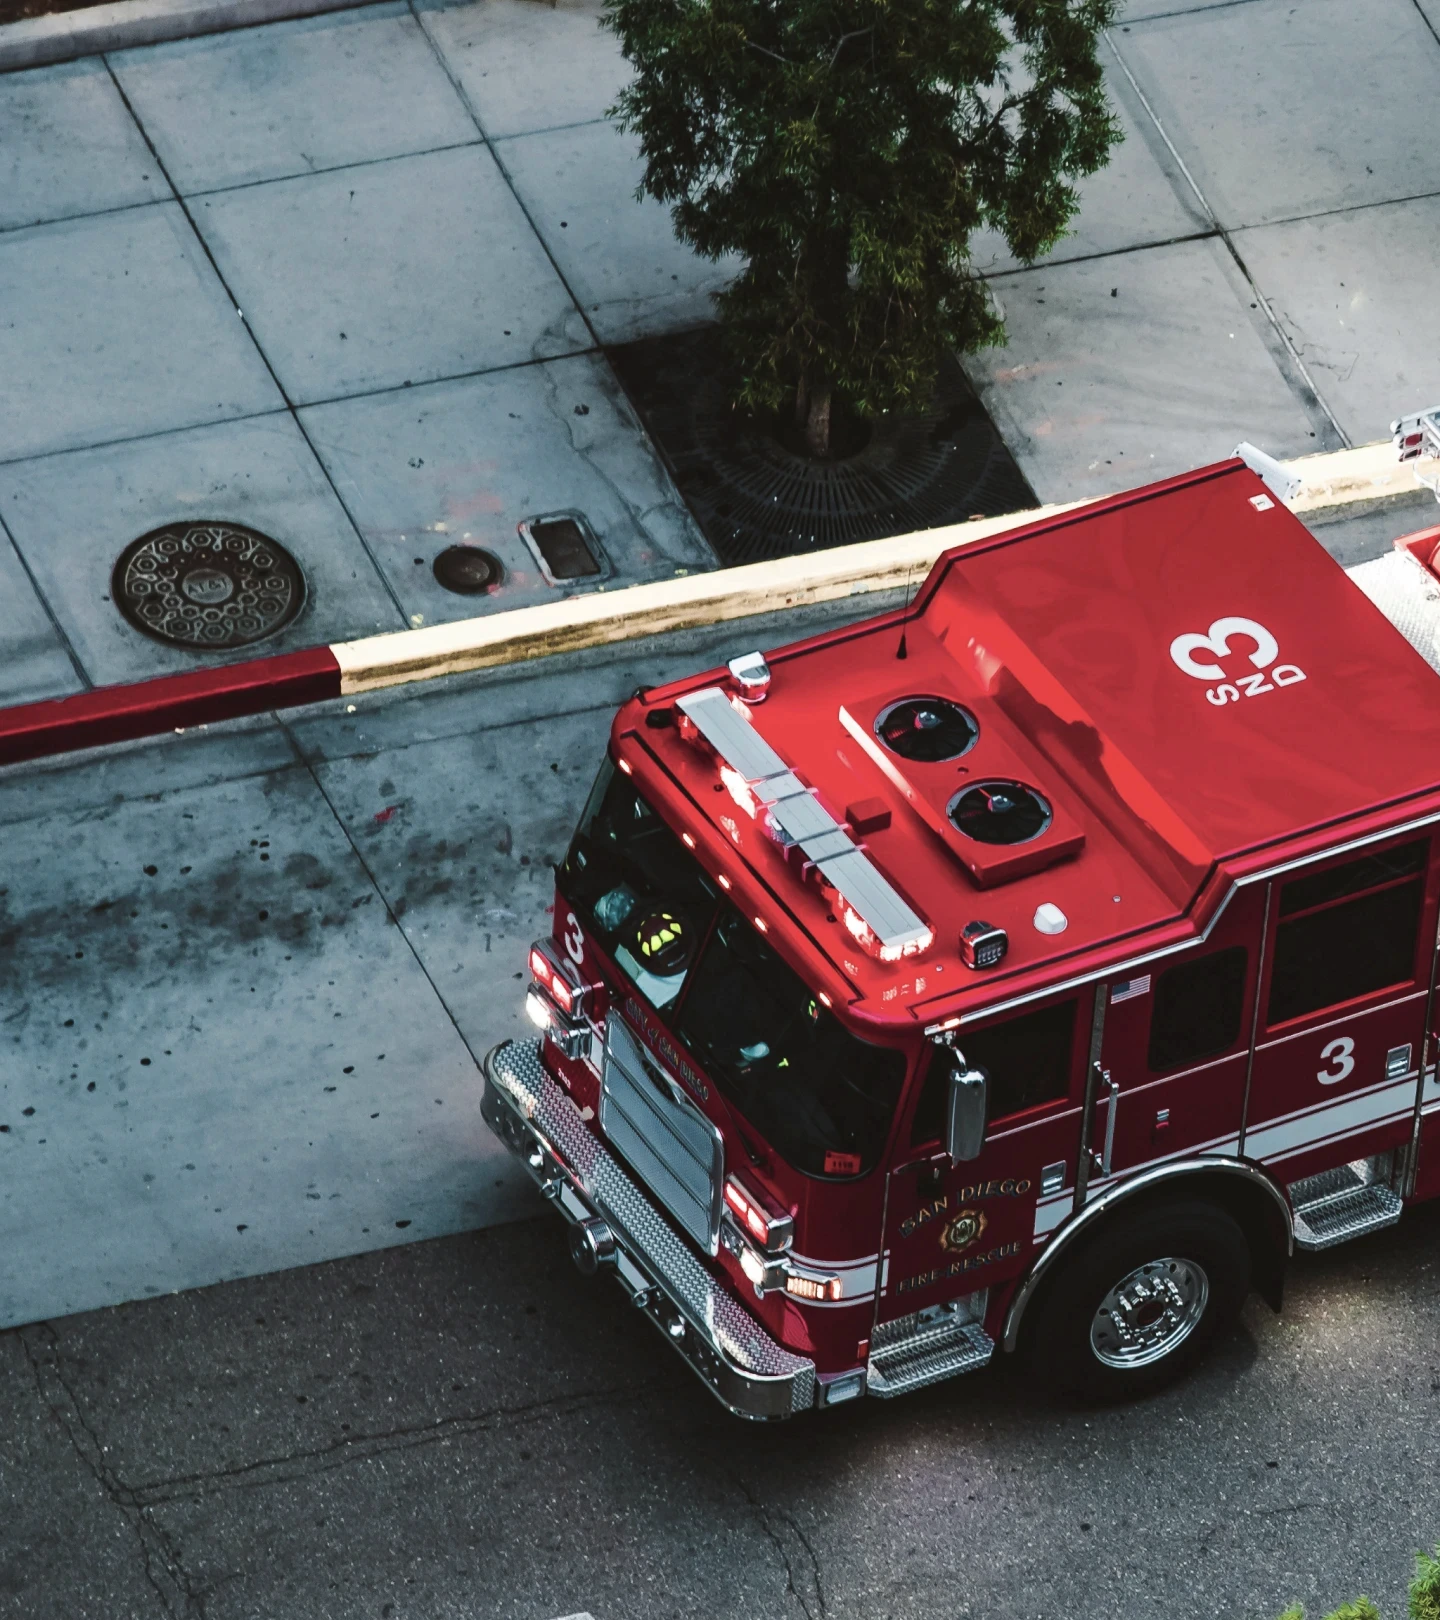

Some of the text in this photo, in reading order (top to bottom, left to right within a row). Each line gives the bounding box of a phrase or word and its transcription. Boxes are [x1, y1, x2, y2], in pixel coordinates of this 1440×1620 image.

[1170, 617, 1307, 706] SND 3
[565, 913, 584, 965] 3
[626, 997, 648, 1031] CITY
[659, 1036, 679, 1070] SAN
[680, 1059, 709, 1102] DIEGO
[1317, 1037, 1355, 1085] 3
[900, 1179, 1031, 1237] SAN DIEGO
